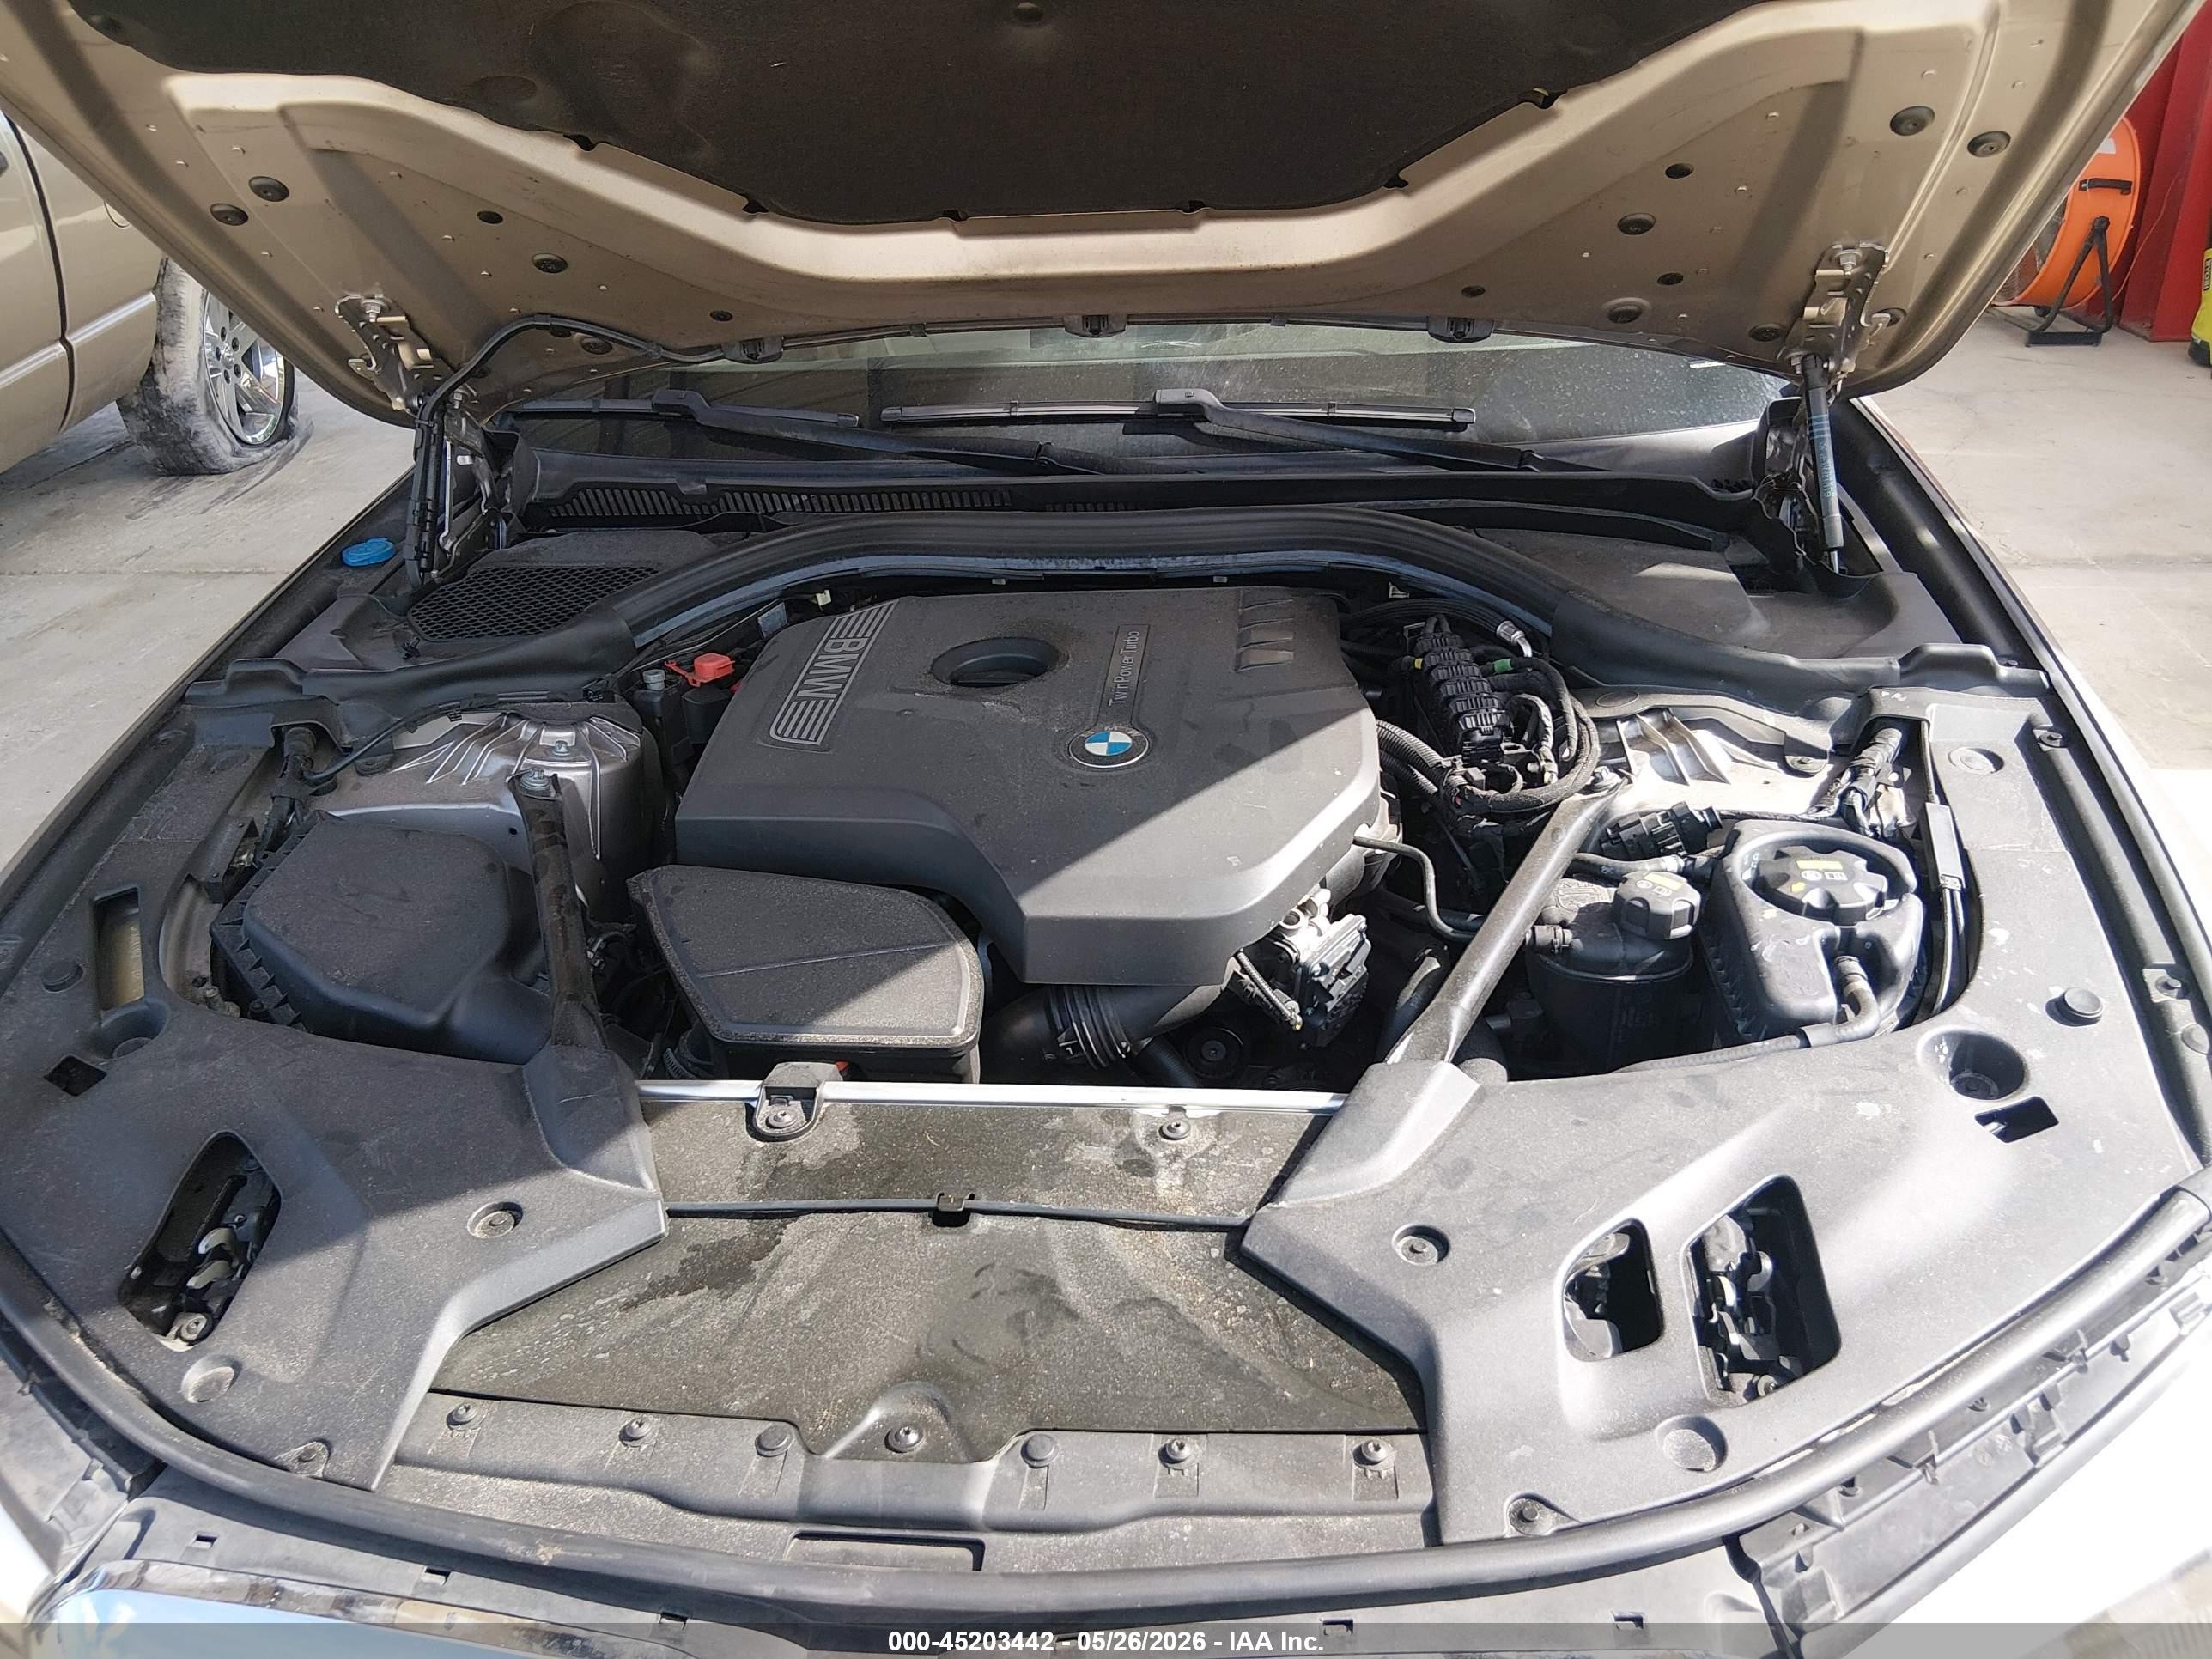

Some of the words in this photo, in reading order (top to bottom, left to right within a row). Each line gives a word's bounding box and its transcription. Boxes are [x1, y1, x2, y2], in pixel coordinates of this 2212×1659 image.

[1120, 630, 1140, 655] Turbo
[796, 638, 869, 699] BMW
[1108, 656, 1134, 707] TwinPower
